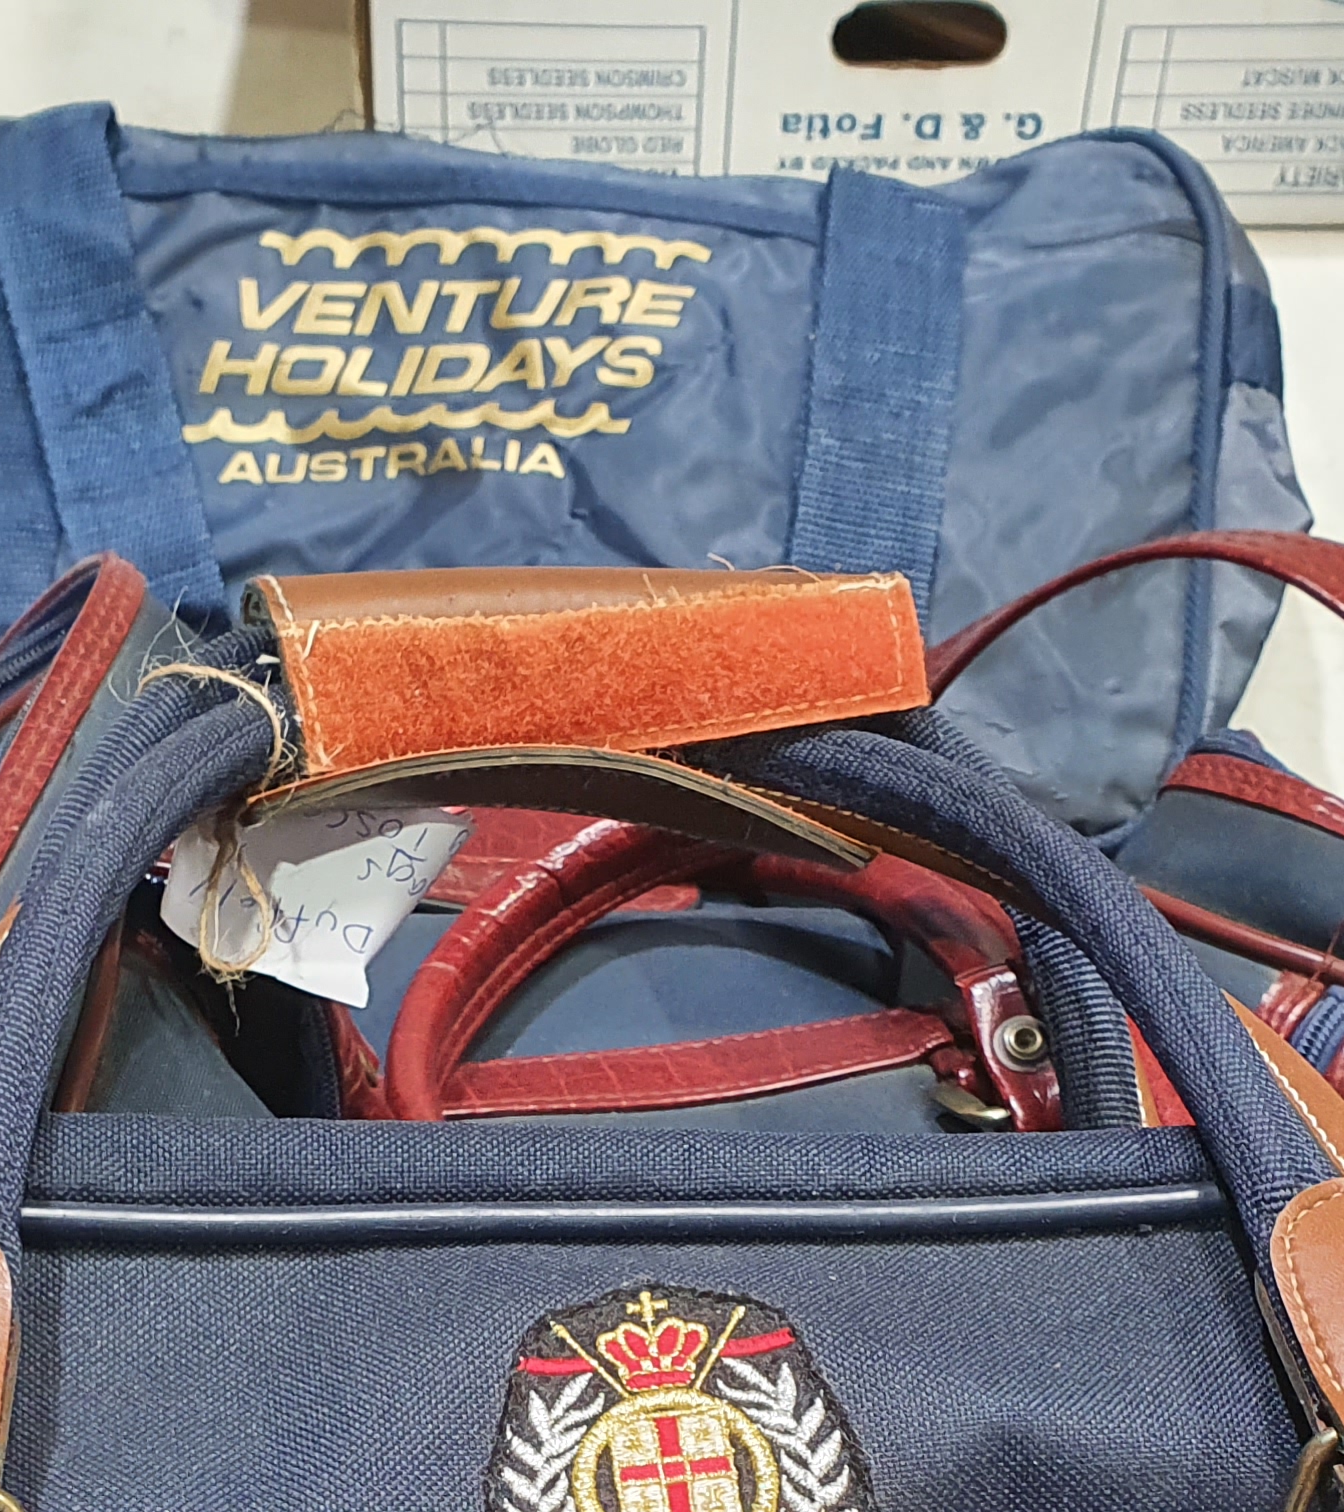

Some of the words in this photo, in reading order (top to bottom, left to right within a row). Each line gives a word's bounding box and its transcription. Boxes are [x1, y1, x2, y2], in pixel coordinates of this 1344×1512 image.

[486, 66, 590, 87] SEEDLESS
[1240, 67, 1321, 87] MUSCAT
[467, 101, 569, 121] SEEDLESS
[575, 102, 684, 121] THOMPSON
[1179, 101, 1283, 121] SEEDLESS
[780, 111, 884, 141] Fotia
[902, 112, 943, 141] D.
[960, 112, 986, 141] &
[1003, 112, 1044, 141] G.
[642, 136, 685, 154] RED
[1221, 134, 1310, 154] AMERICA
[238, 275, 697, 337] VENTURE
[198, 335, 663, 398] HOLIDAYS
[217, 436, 567, 486] AUSTRALIA
